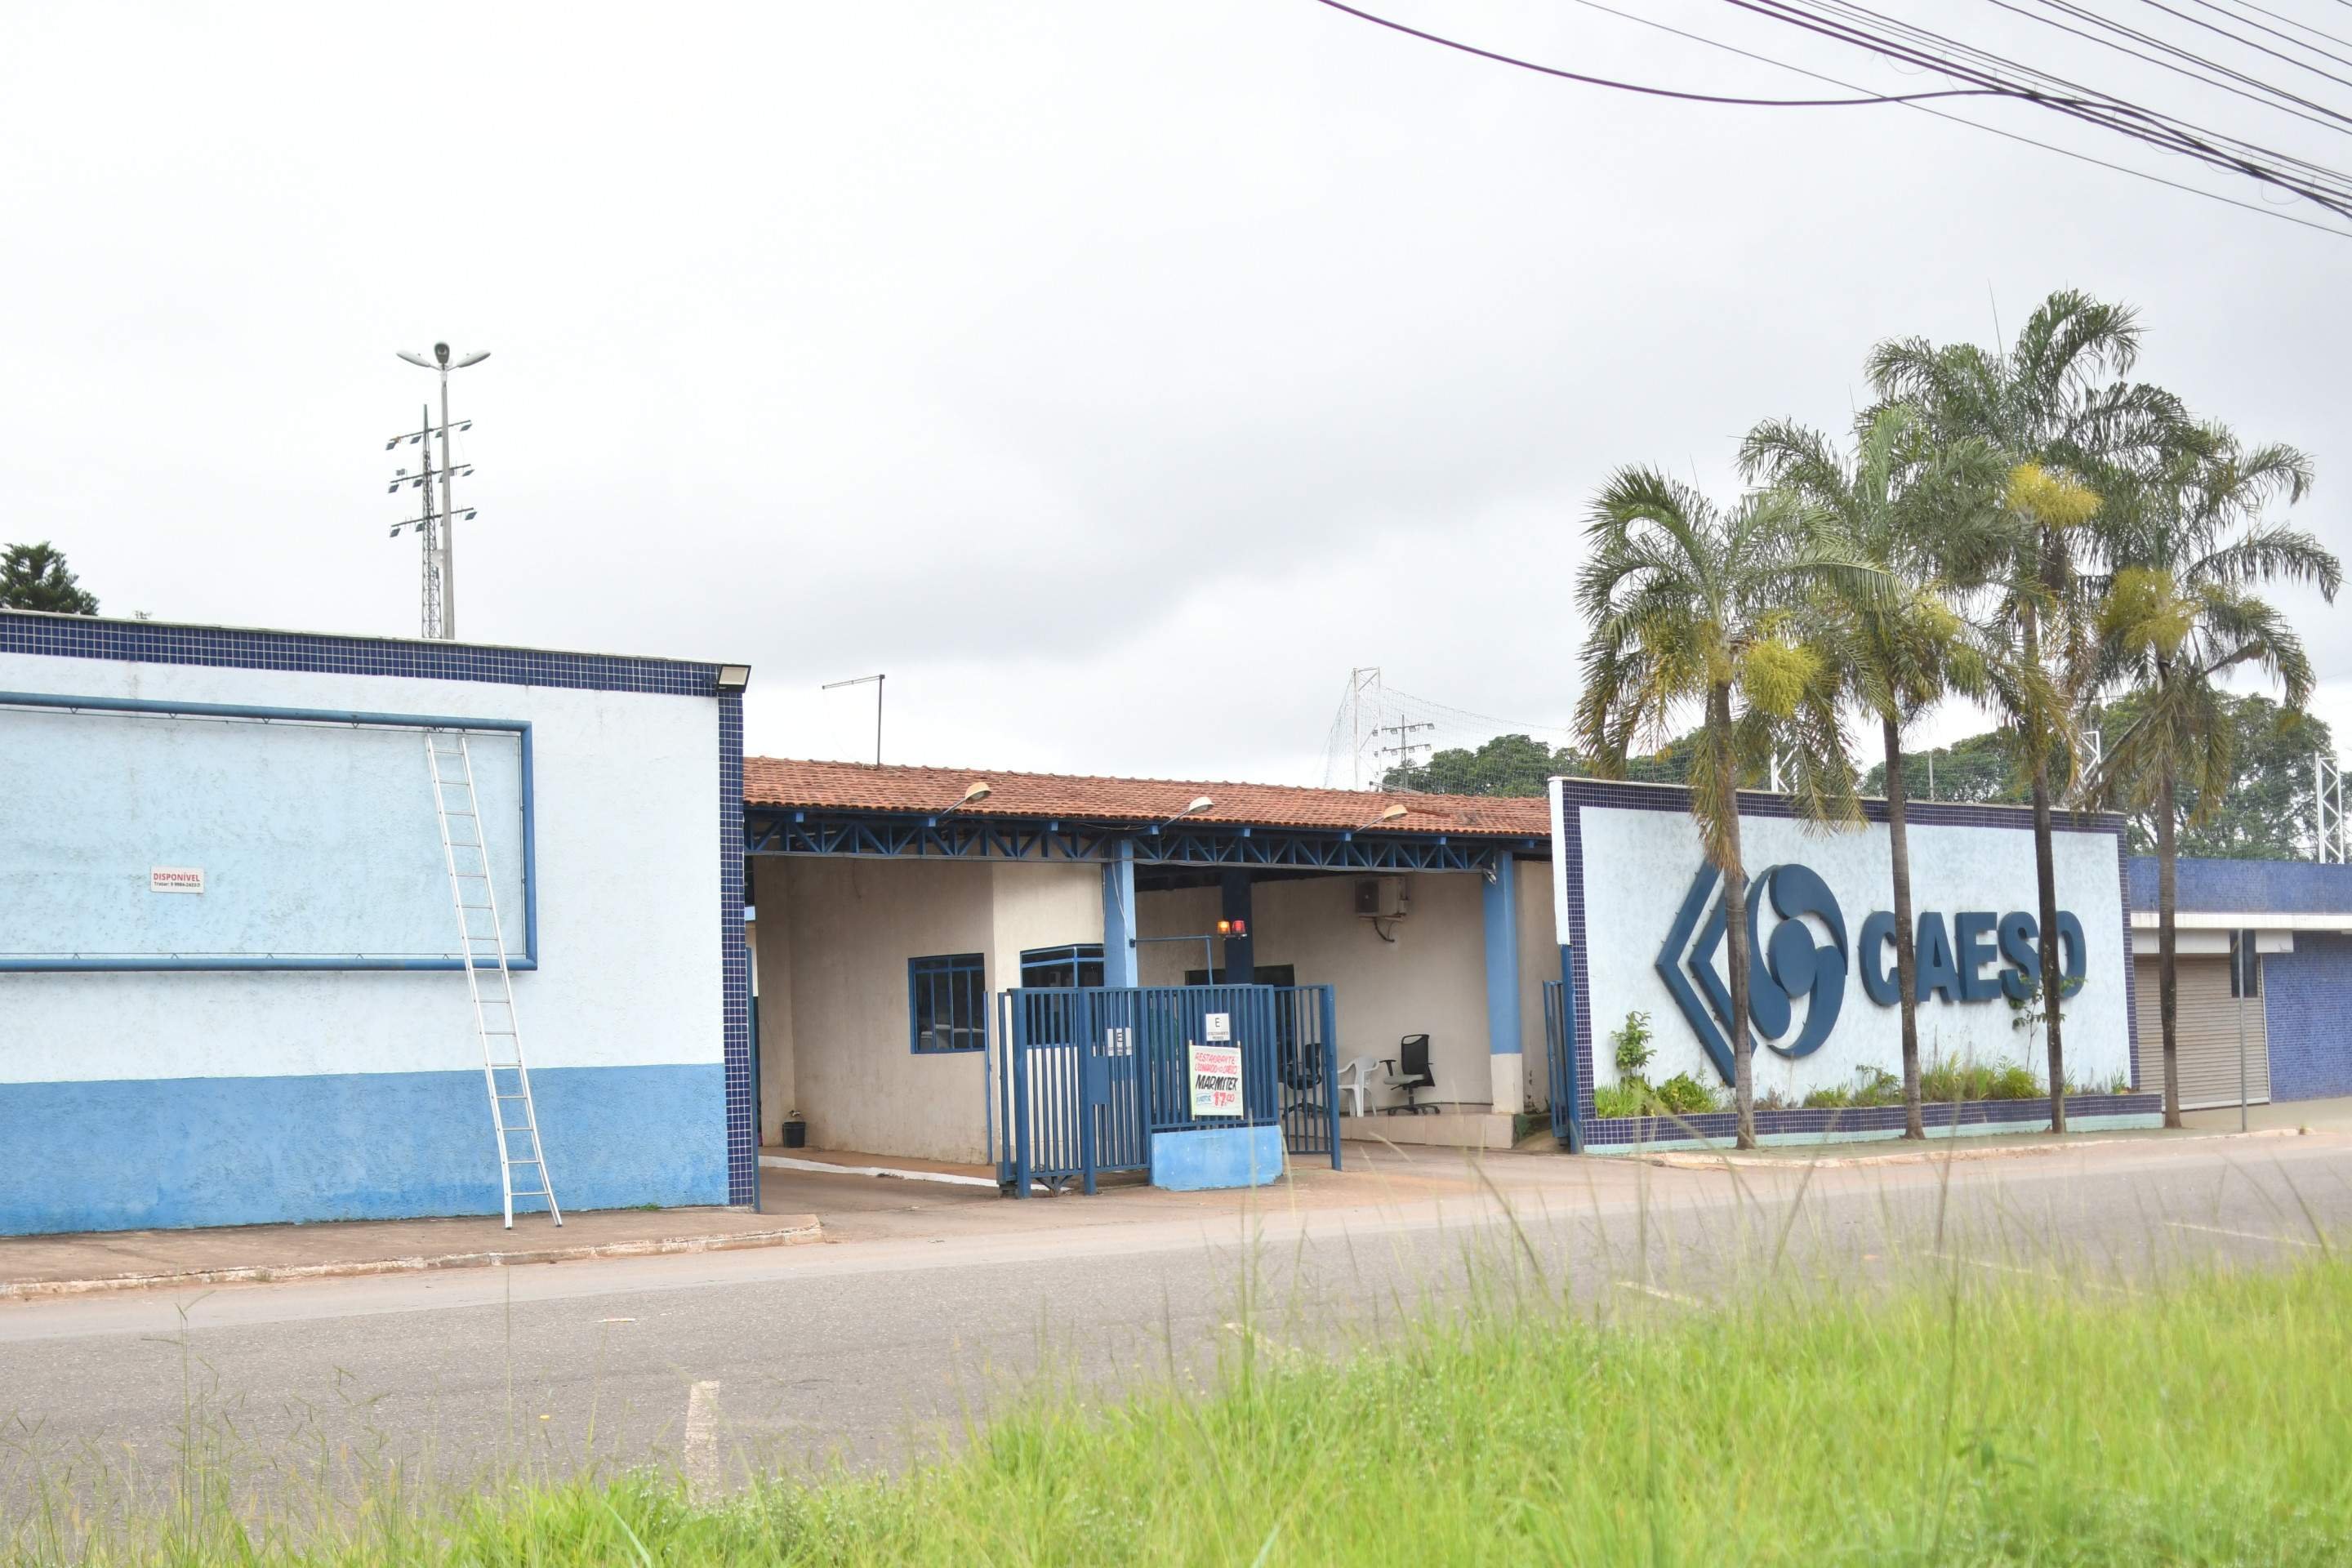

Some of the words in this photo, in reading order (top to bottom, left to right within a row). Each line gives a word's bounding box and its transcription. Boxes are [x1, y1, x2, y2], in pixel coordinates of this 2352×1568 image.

[154, 872, 200, 881] DISPONÍVEL
[1859, 910, 2087, 1007] CAESO
[1215, 1018, 1221, 1027] E
[1196, 1074, 1238, 1091] MARMITEX
